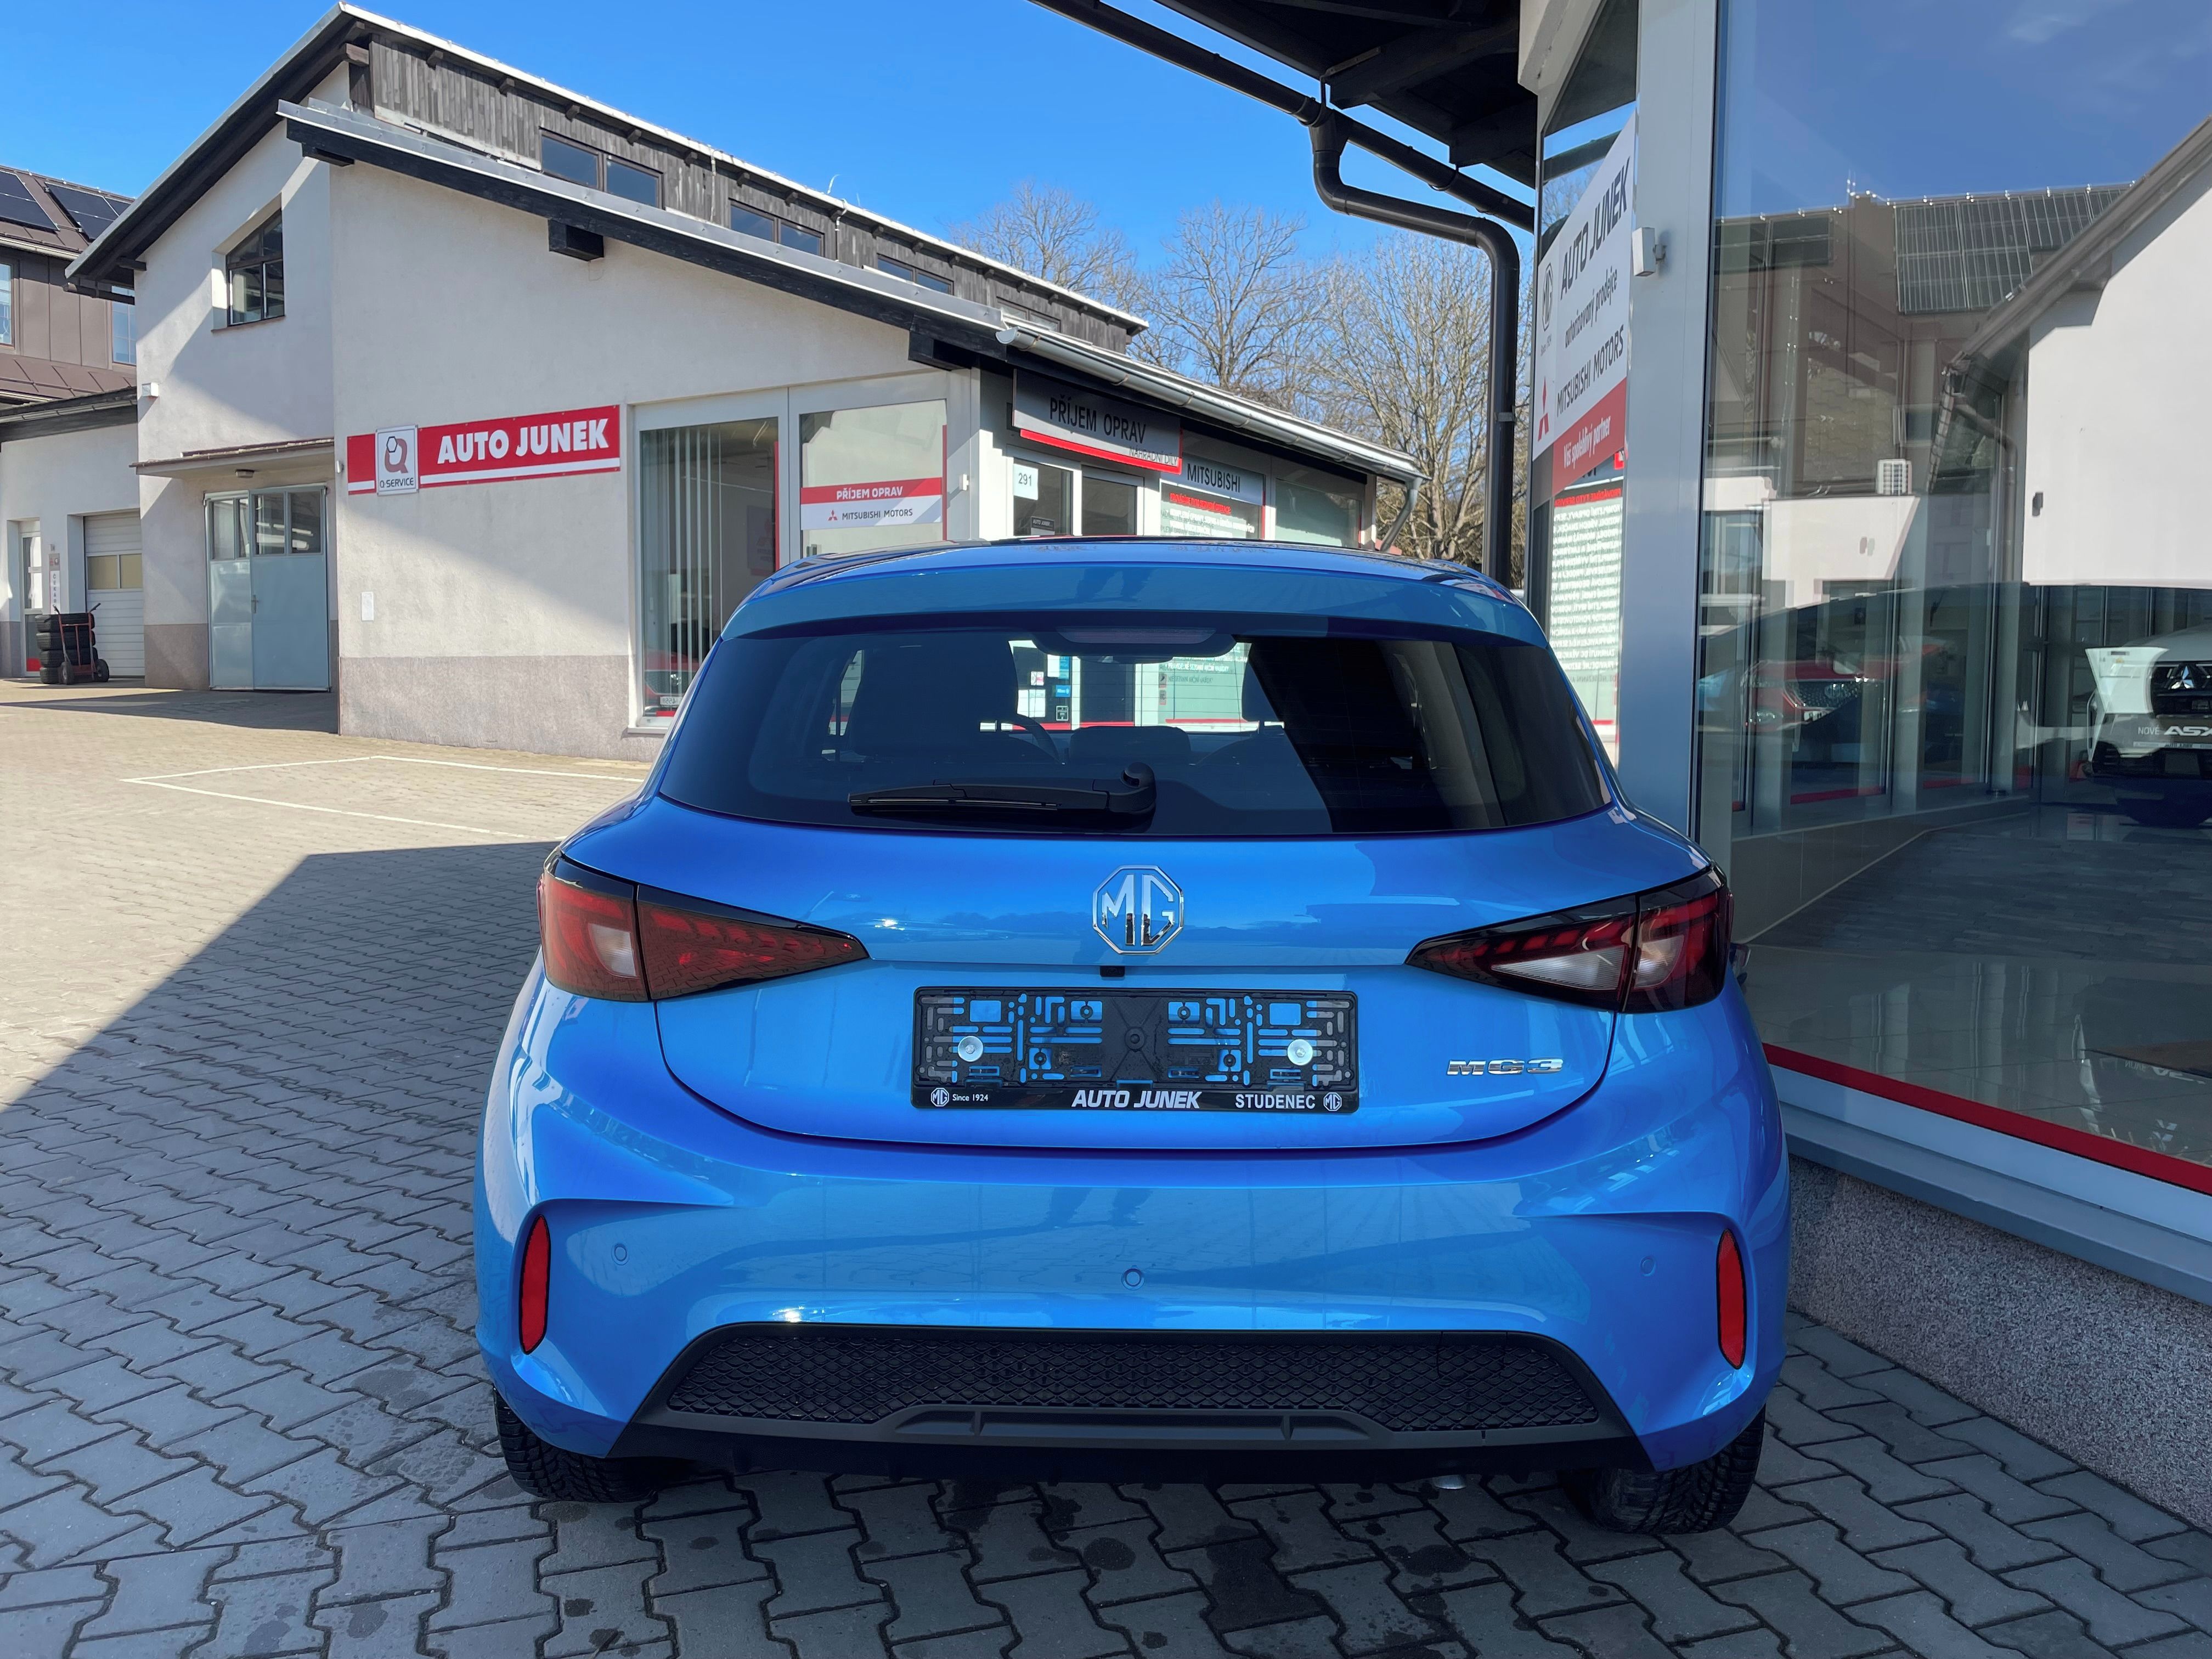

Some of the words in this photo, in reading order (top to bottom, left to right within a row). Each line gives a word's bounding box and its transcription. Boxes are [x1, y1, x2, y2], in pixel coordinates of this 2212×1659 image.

[1560, 221, 1588, 301] AUTO
[1589, 156, 1630, 261] JUNEK
[1565, 289, 1595, 349] autorizovaný
[1595, 266, 1617, 323] prodejce
[1556, 359, 1591, 417] MITSUBISHI
[1593, 324, 1624, 382] MOTORS
[1049, 394, 1097, 433] PŘÍJEM
[1103, 413, 1146, 444] OPRAV
[437, 429, 510, 465] AUTO
[515, 418, 610, 457] JUNEK
[1592, 415, 1611, 455] partner
[1018, 472, 1032, 487] 291
[1187, 463, 1241, 493] MITSUBISHI
[836, 487, 870, 500] PŘÍJEM
[872, 486, 904, 498] OPRAV
[842, 510, 881, 521] MITSUBISHI
[884, 508, 913, 518] MOTORS
[2137, 725, 2160, 735] NOVÉ
[1101, 873, 1175, 947] MG
[1446, 1057, 1564, 1076] MG3
[952, 1093, 969, 1102] Since
[1070, 1089, 1131, 1108] AUTO
[1133, 1090, 1202, 1109] JUNEK
[1235, 1093, 1316, 1110] STUDENEC
